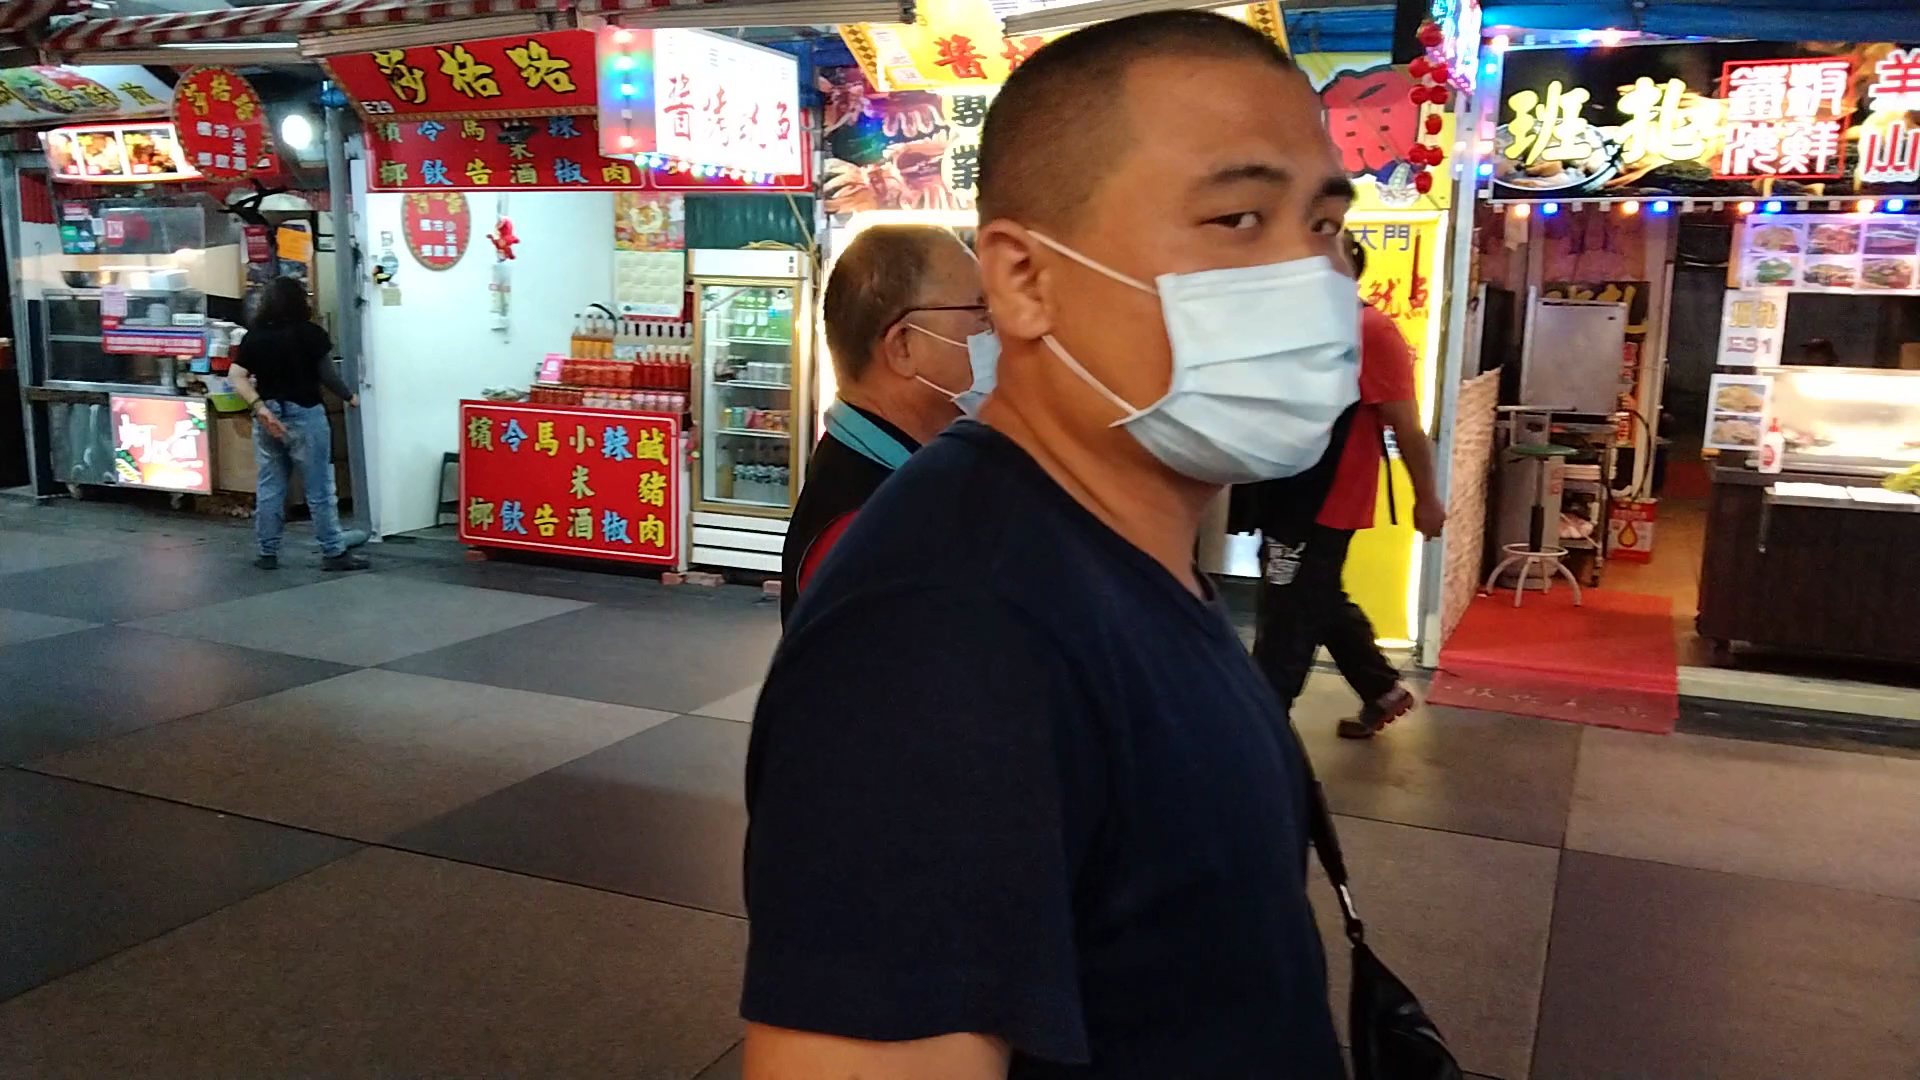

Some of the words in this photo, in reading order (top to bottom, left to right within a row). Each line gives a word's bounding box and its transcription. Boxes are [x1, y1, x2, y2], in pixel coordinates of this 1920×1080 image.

[500, 418, 528, 535] 冷飲
[534, 421, 559, 537] 馬告
[567, 425, 596, 541] 小米酒
[601, 425, 633, 545] 辣椒
[636, 427, 669, 548] 鹹豬肉
